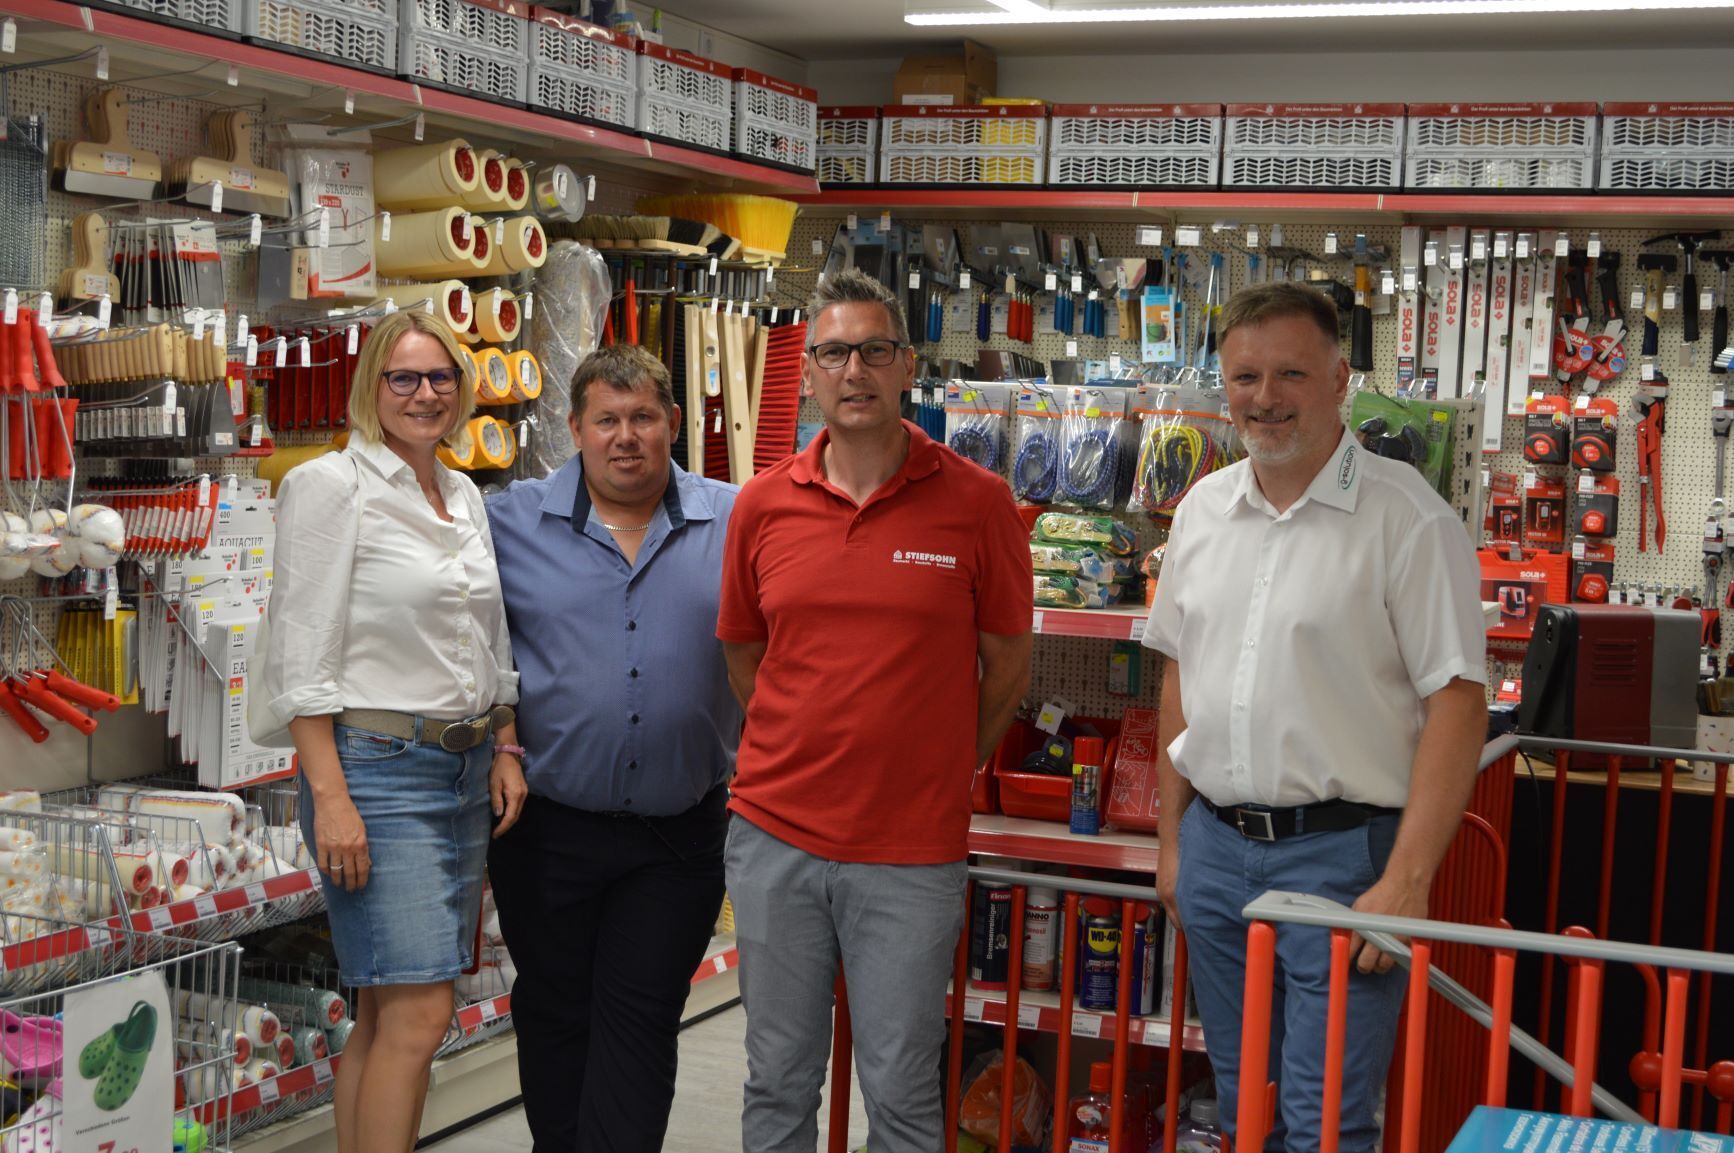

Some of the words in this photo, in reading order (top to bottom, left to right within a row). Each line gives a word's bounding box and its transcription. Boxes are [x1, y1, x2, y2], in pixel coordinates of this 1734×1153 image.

[325, 183, 364, 196] STARDUST
[1445, 281, 1458, 315] SOLA
[1494, 276, 1507, 310] SOLA
[1471, 284, 1483, 317] SOLA
[1401, 308, 1413, 342] SOLA
[1427, 312, 1439, 346] SOLA
[252, 556, 263, 565] 100
[905, 551, 956, 565] STIEFSOHN
[202, 611, 214, 621] 120
[233, 634, 245, 643] 120
[1024, 911, 1049, 921] ANNO
[986, 903, 997, 960] Bremsenreiniger
[1090, 930, 1118, 942] WD-40
[1077, 1142, 1102, 1152] SONAX
